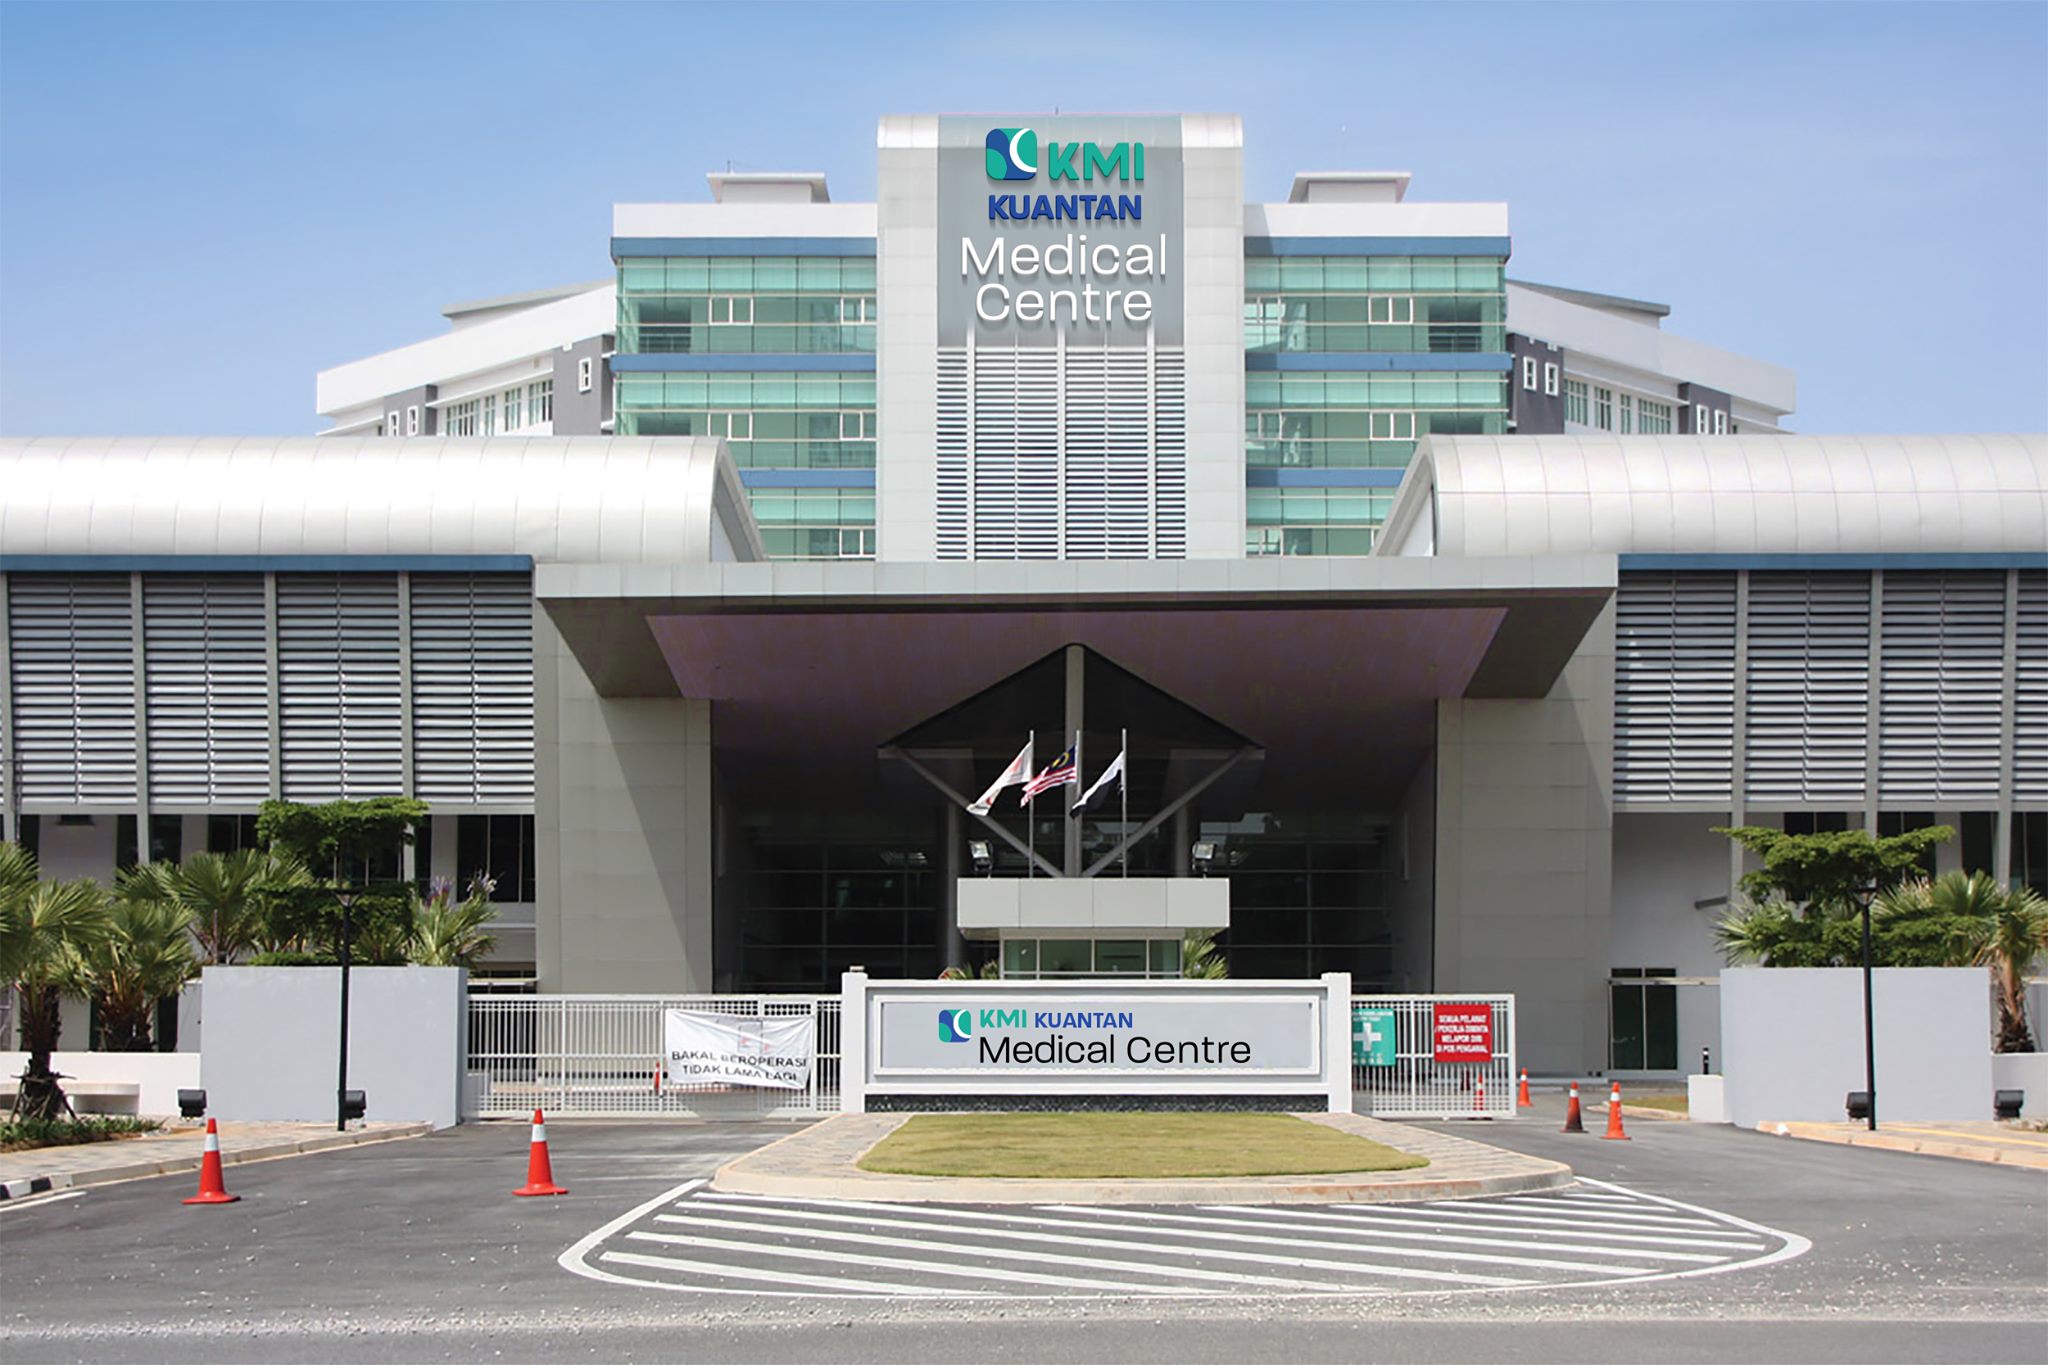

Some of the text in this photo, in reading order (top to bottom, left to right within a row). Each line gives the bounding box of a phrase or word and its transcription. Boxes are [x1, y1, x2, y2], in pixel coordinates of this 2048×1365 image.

[1048, 142, 1145, 180] KMI
[988, 194, 1142, 220] KUANTAN
[961, 233, 1166, 276] Medical
[976, 283, 1152, 321] Centre
[979, 1009, 1133, 1029] KMI KUANTAN
[671, 1050, 717, 1061] BAKAL
[979, 1034, 1252, 1064] Medical Centre
[682, 1064, 798, 1082] TIDAK LAMA LAGI
